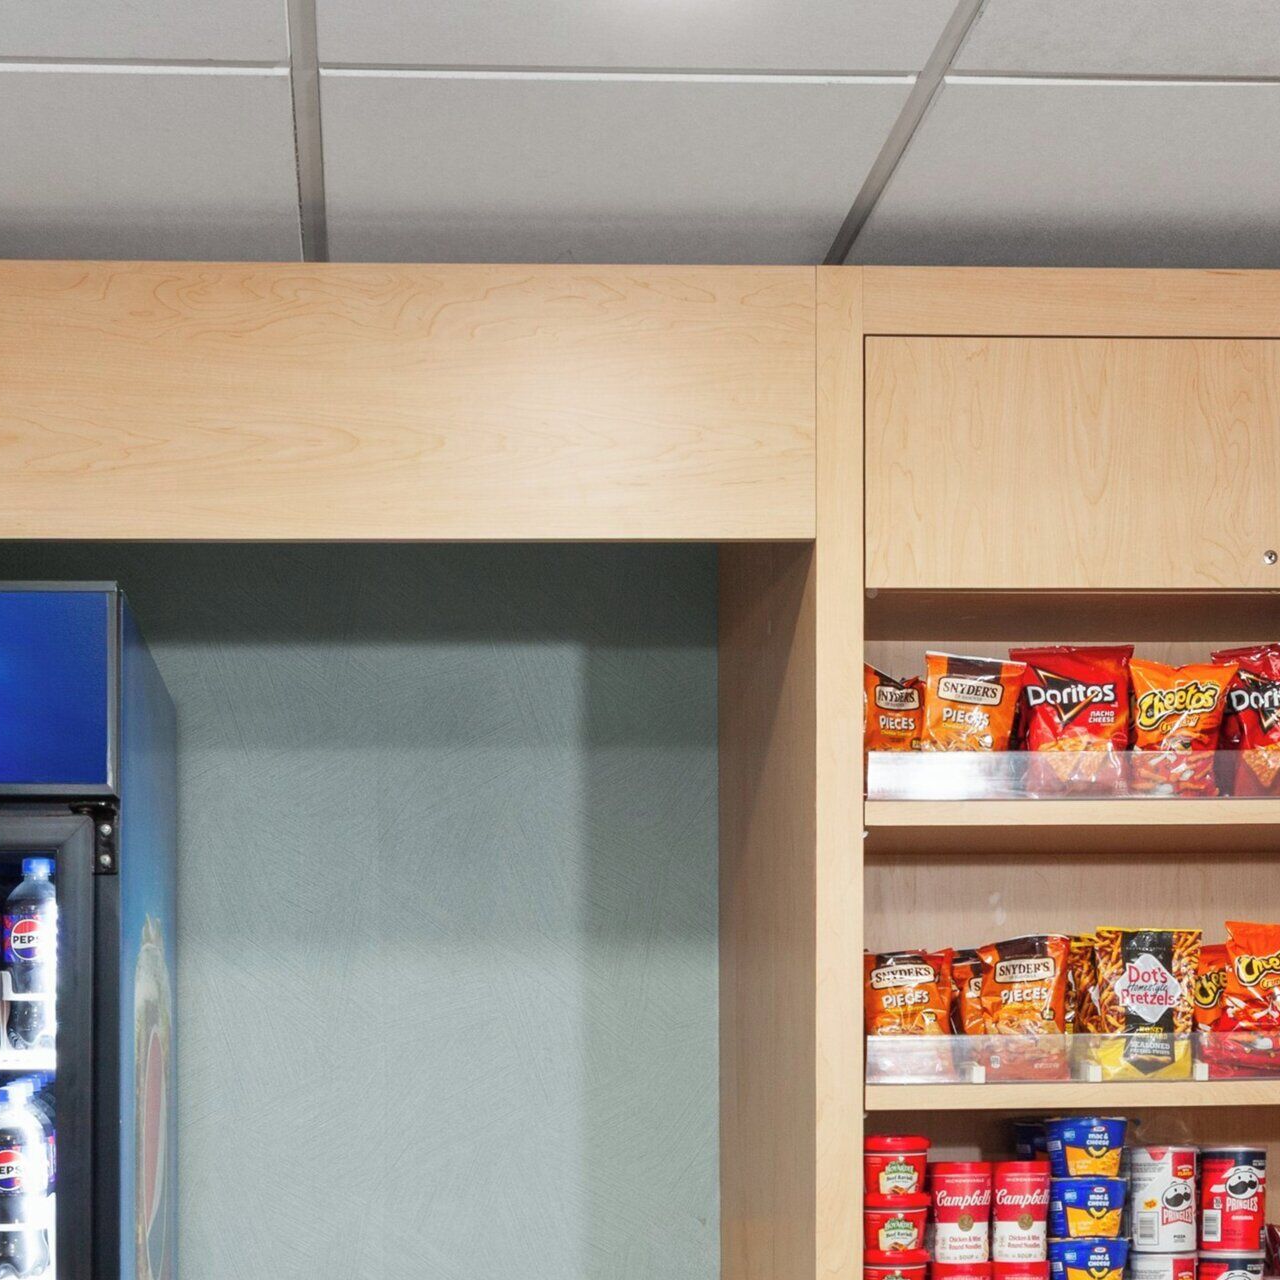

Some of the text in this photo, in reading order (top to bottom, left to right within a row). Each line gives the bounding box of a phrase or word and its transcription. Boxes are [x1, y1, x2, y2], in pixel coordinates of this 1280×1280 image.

[943, 681, 998, 698] SNYDER'S
[1027, 684, 1115, 706] Doritos
[1139, 685, 1218, 728] Cheetos
[880, 715, 915, 730] PIECES
[999, 962, 1050, 976] SNYDER'S
[1128, 965, 1168, 983] Dot's
[1001, 988, 1048, 1003] PIECES
[1196, 969, 1227, 1004] Chee
[882, 990, 929, 1008] PIECES
[1121, 991, 1175, 1006] Pretzels
[936, 1190, 990, 1209] Campbell
[996, 1189, 1049, 1208] Campbell
[1226, 1197, 1258, 1212] PRINGLES
